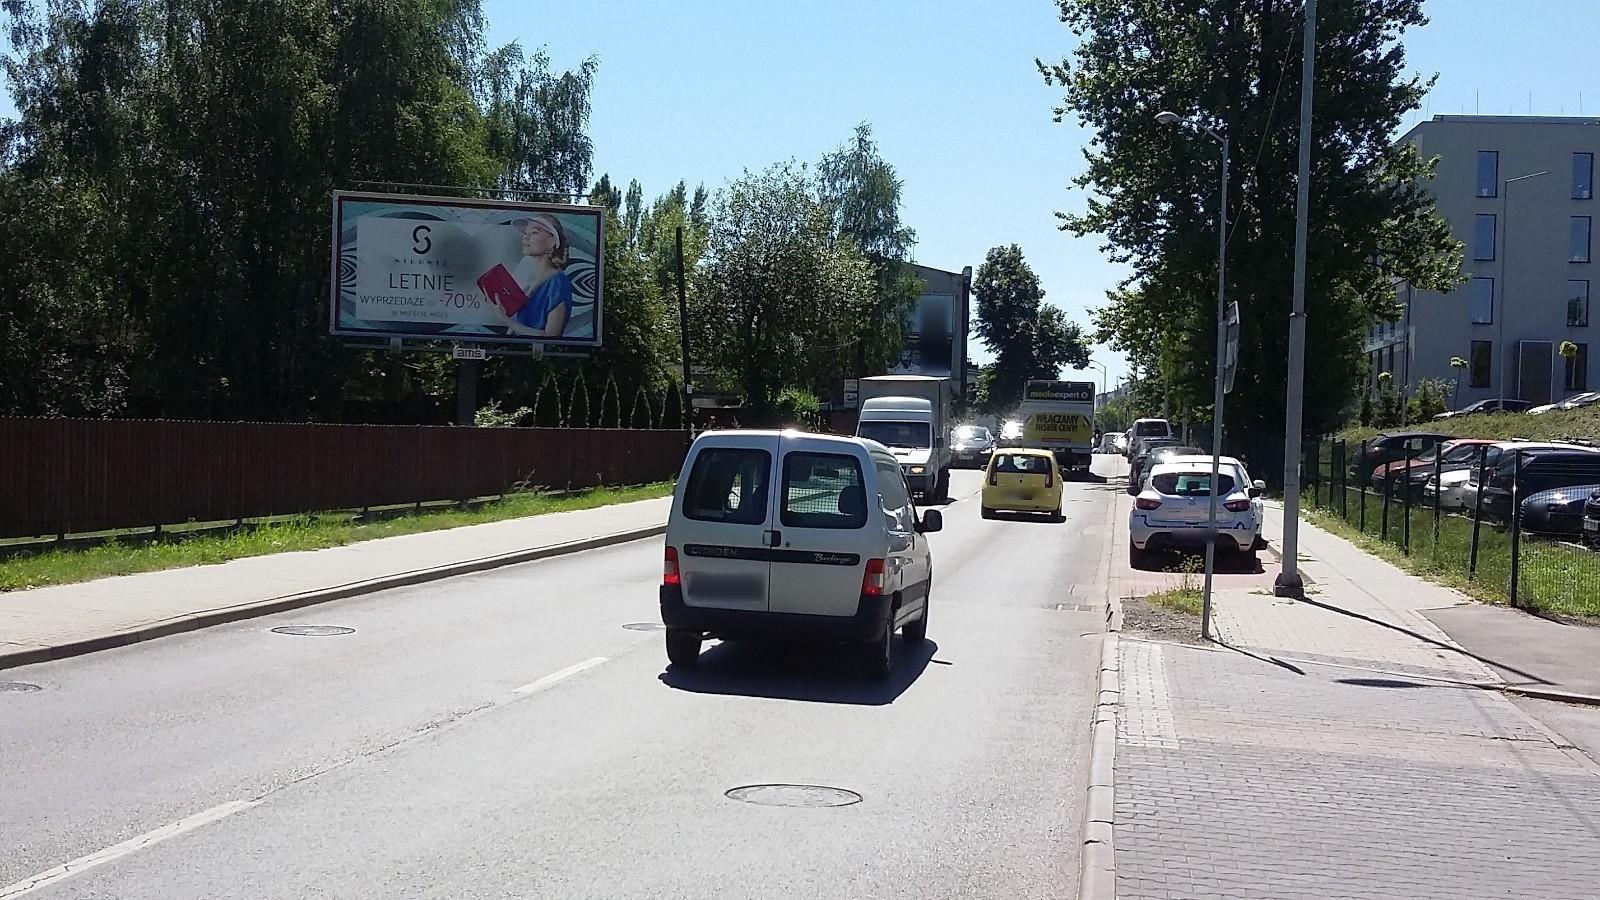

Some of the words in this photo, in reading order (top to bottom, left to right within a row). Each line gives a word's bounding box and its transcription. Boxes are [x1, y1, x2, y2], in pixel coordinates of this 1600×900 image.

[389, 273, 455, 292] LETNIE
[439, 293, 481, 309] -70%
[457, 349, 481, 357] ams
[813, 552, 852, 564] Berlingo
